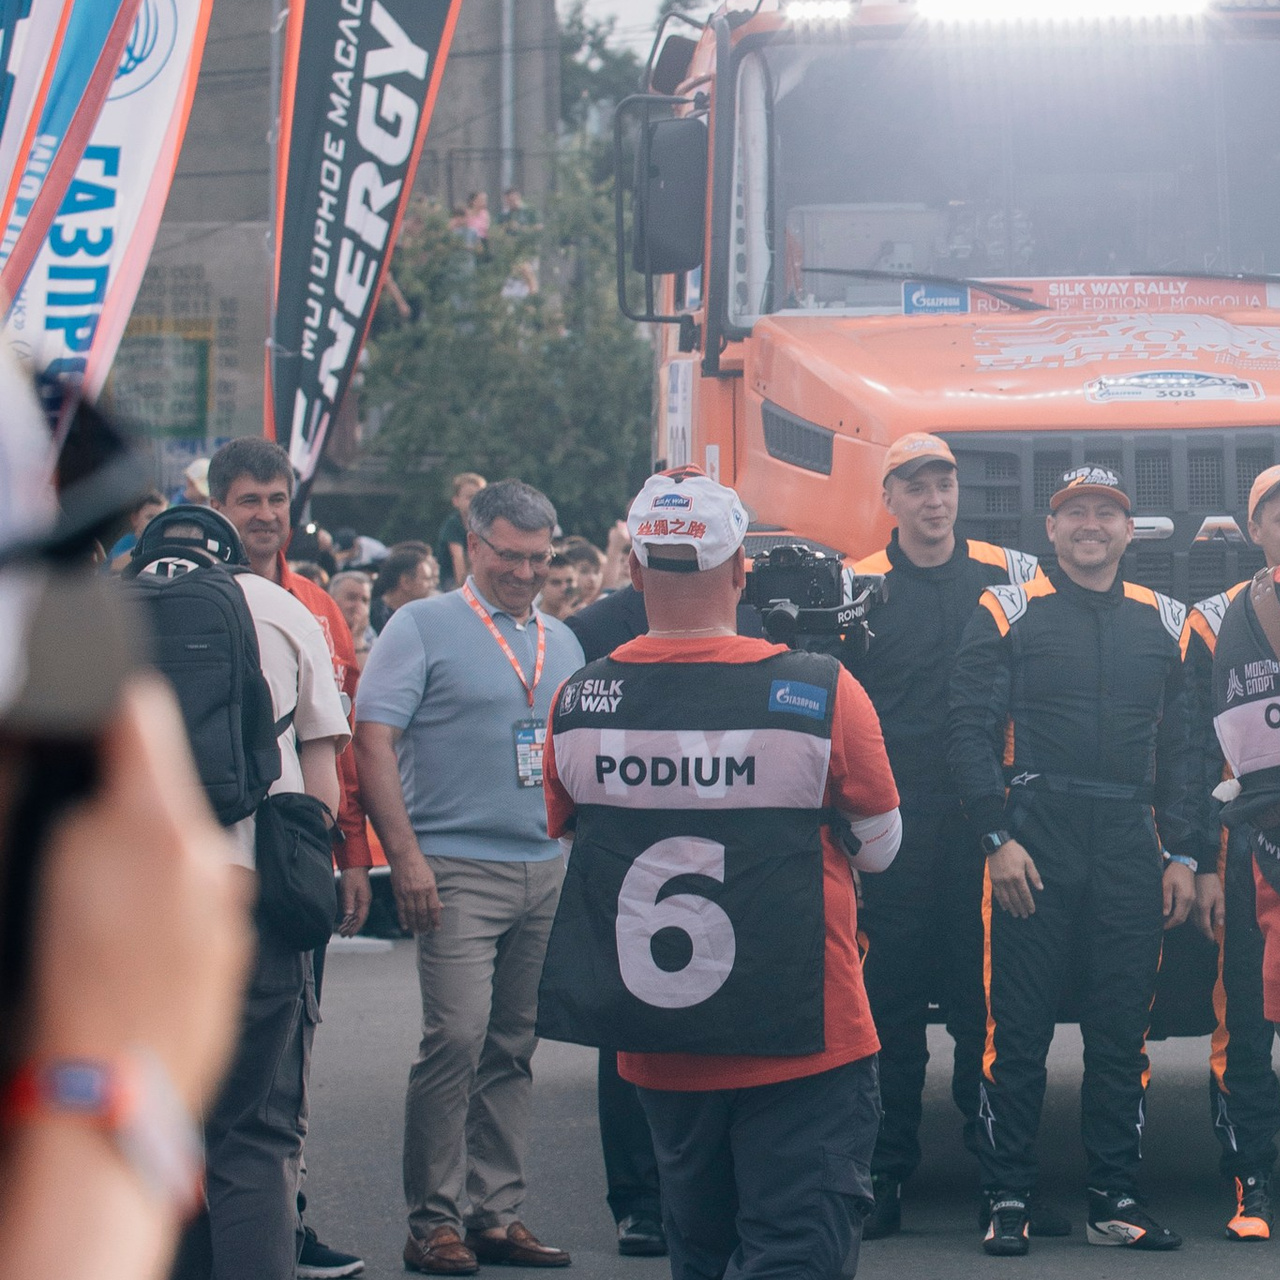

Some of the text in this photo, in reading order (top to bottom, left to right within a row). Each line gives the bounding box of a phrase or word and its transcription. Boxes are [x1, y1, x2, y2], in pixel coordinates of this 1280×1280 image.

[1048, 281, 1189, 297] SILK WAY RALLY
[1083, 296, 1149, 311] EDITION
[837, 604, 866, 624] RONIN
[583, 679, 625, 696] SILK
[1245, 675, 1276, 696] СПОРТ
[581, 696, 623, 713] WAY
[595, 755, 756, 787] PODIUM
[615, 835, 736, 1010] 6
